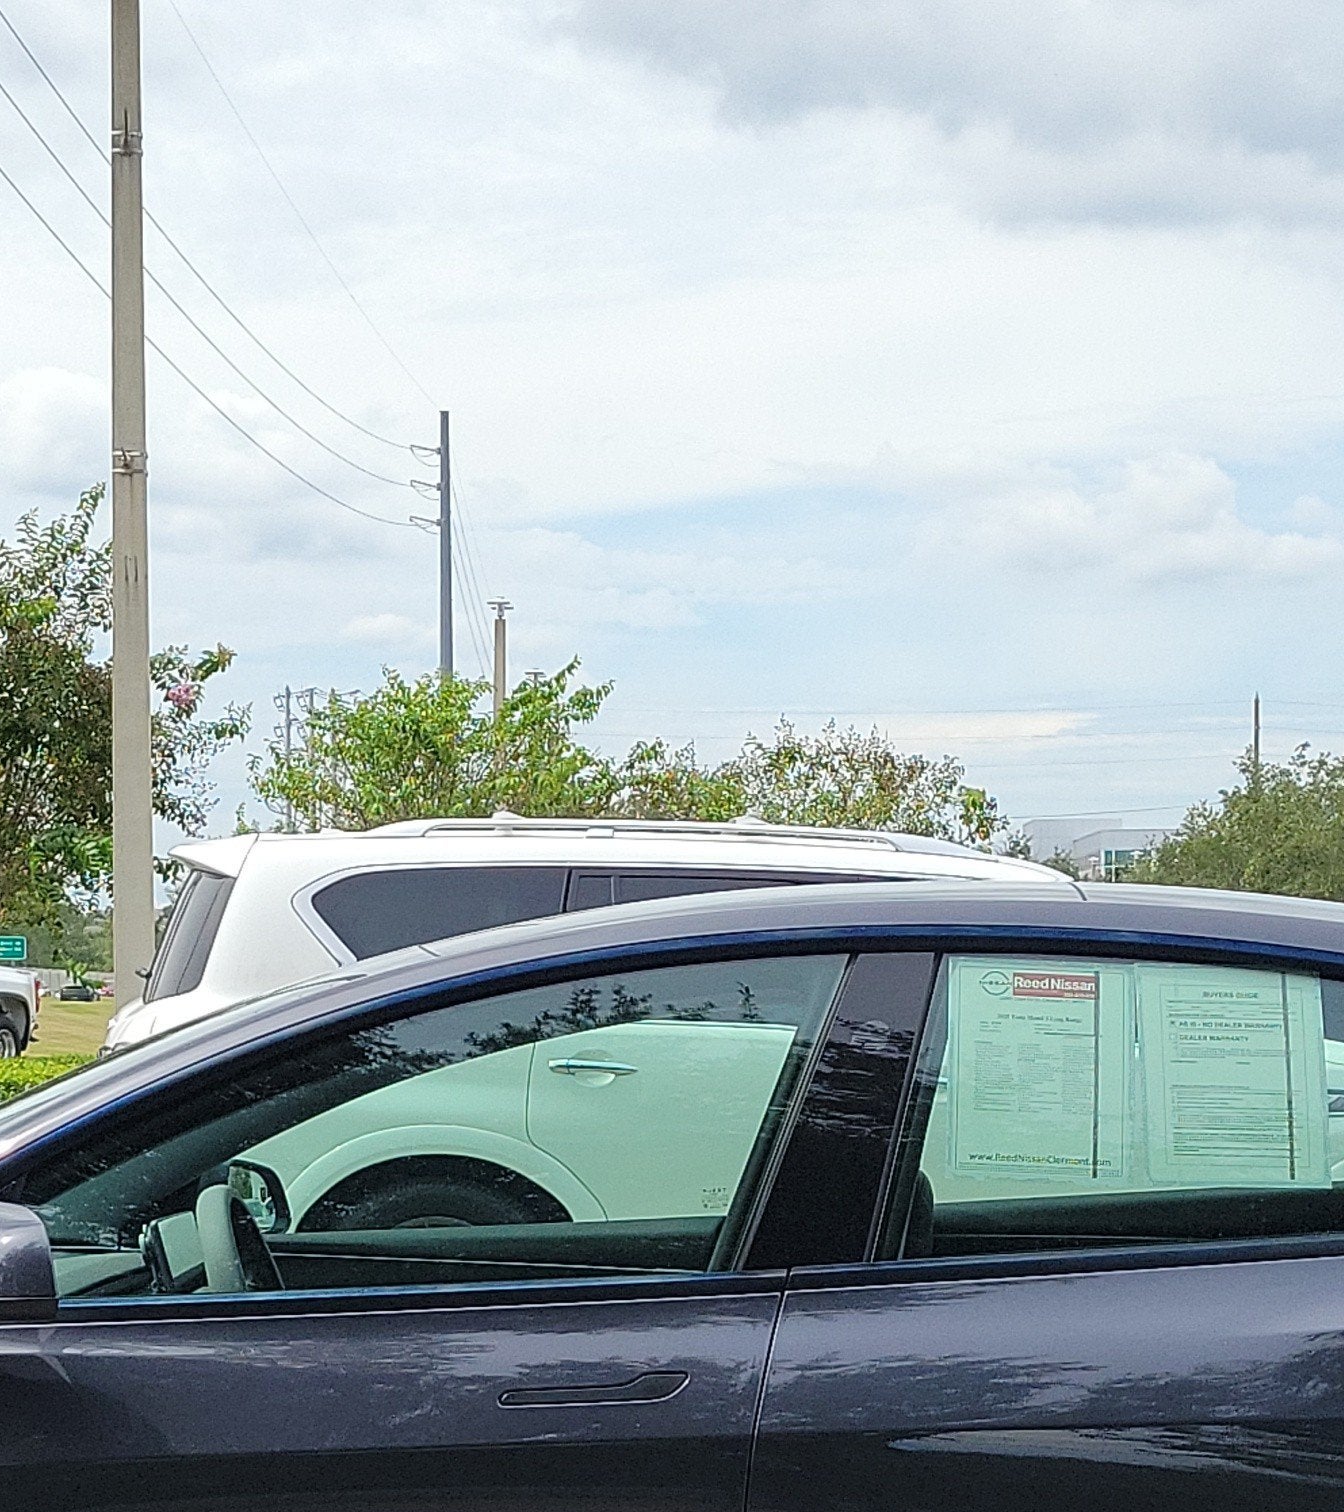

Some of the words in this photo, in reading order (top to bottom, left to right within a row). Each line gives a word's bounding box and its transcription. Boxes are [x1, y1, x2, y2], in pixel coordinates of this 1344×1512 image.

[1014, 976, 1049, 989] Reed
[1050, 978, 1096, 991] Nissan
[968, 1153, 1112, 1167] www.ReedNissanClermont.om
